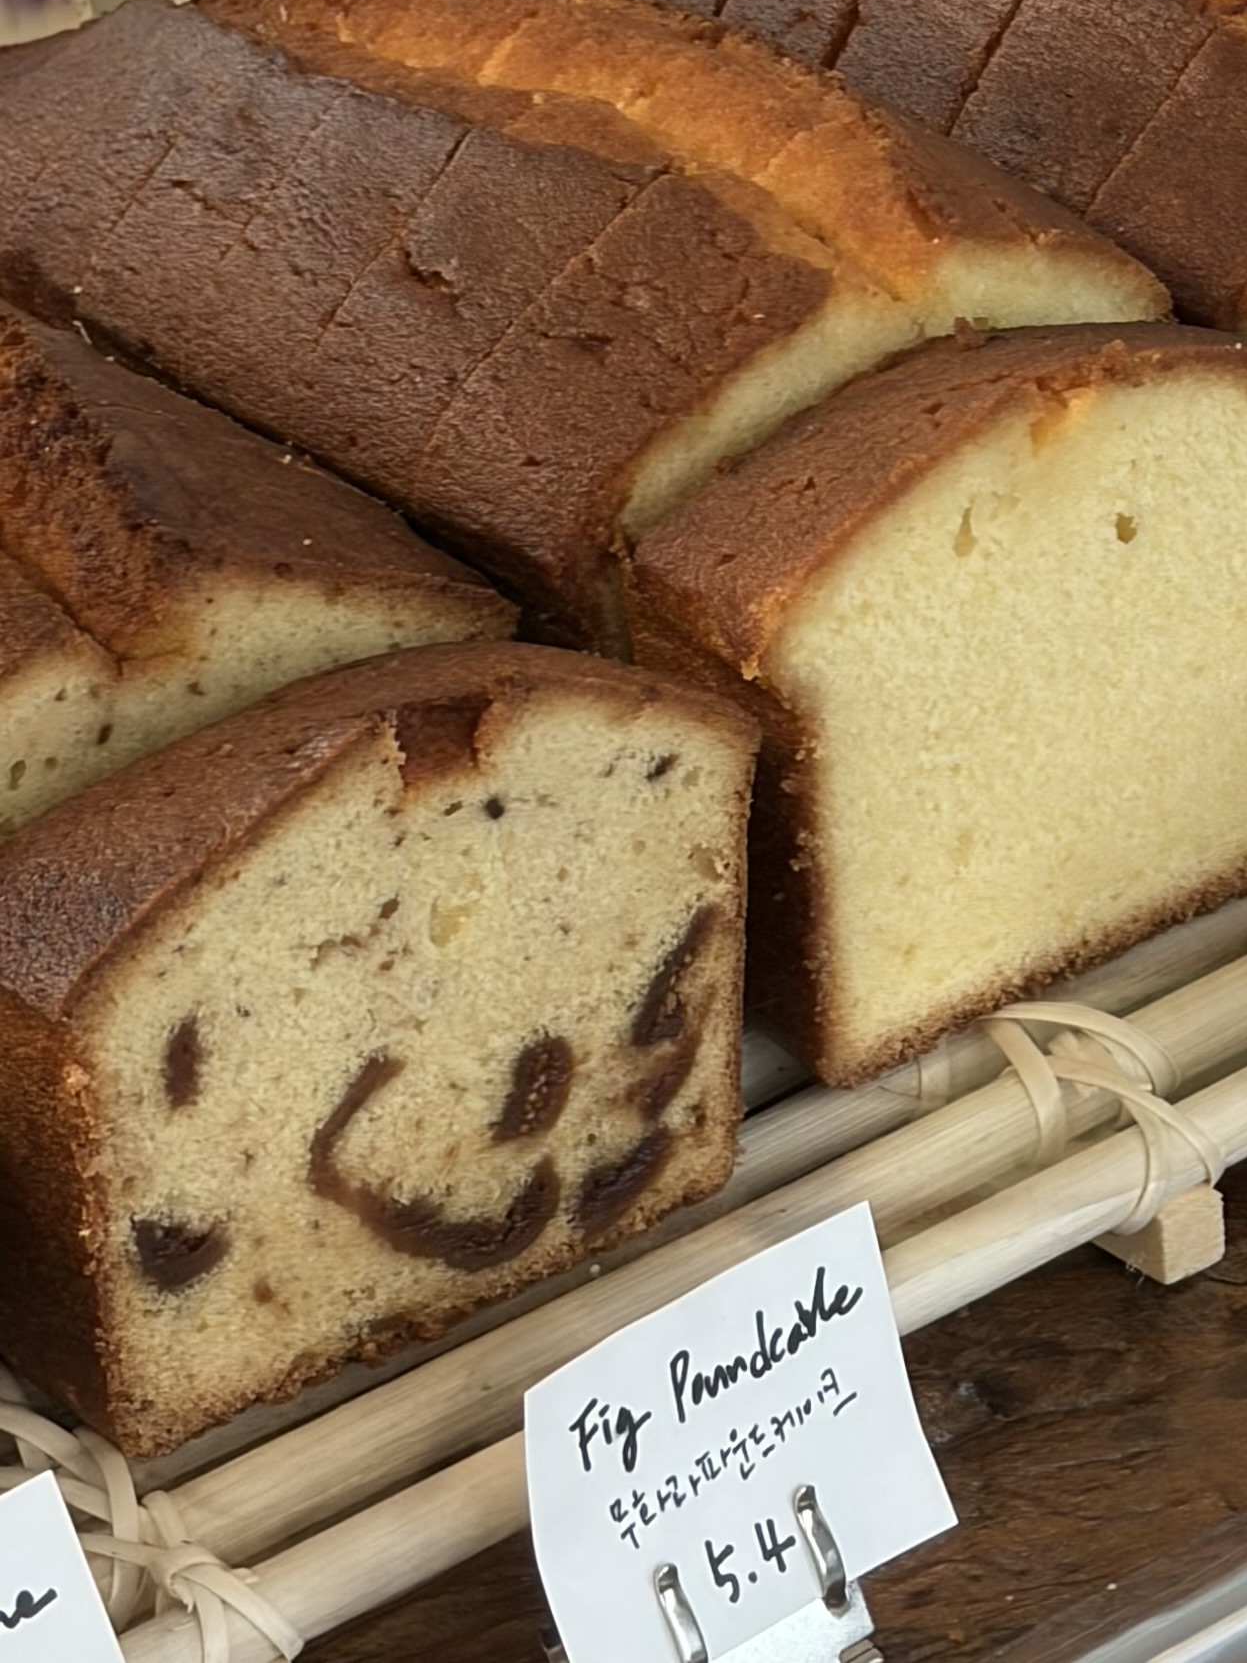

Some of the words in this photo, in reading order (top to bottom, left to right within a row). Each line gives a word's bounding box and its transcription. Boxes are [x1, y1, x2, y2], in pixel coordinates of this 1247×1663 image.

[568, 1397, 653, 1474] Fig
[608, 1367, 859, 1550] 무화과파운드케이크
[705, 1518, 796, 1603] 5.4
